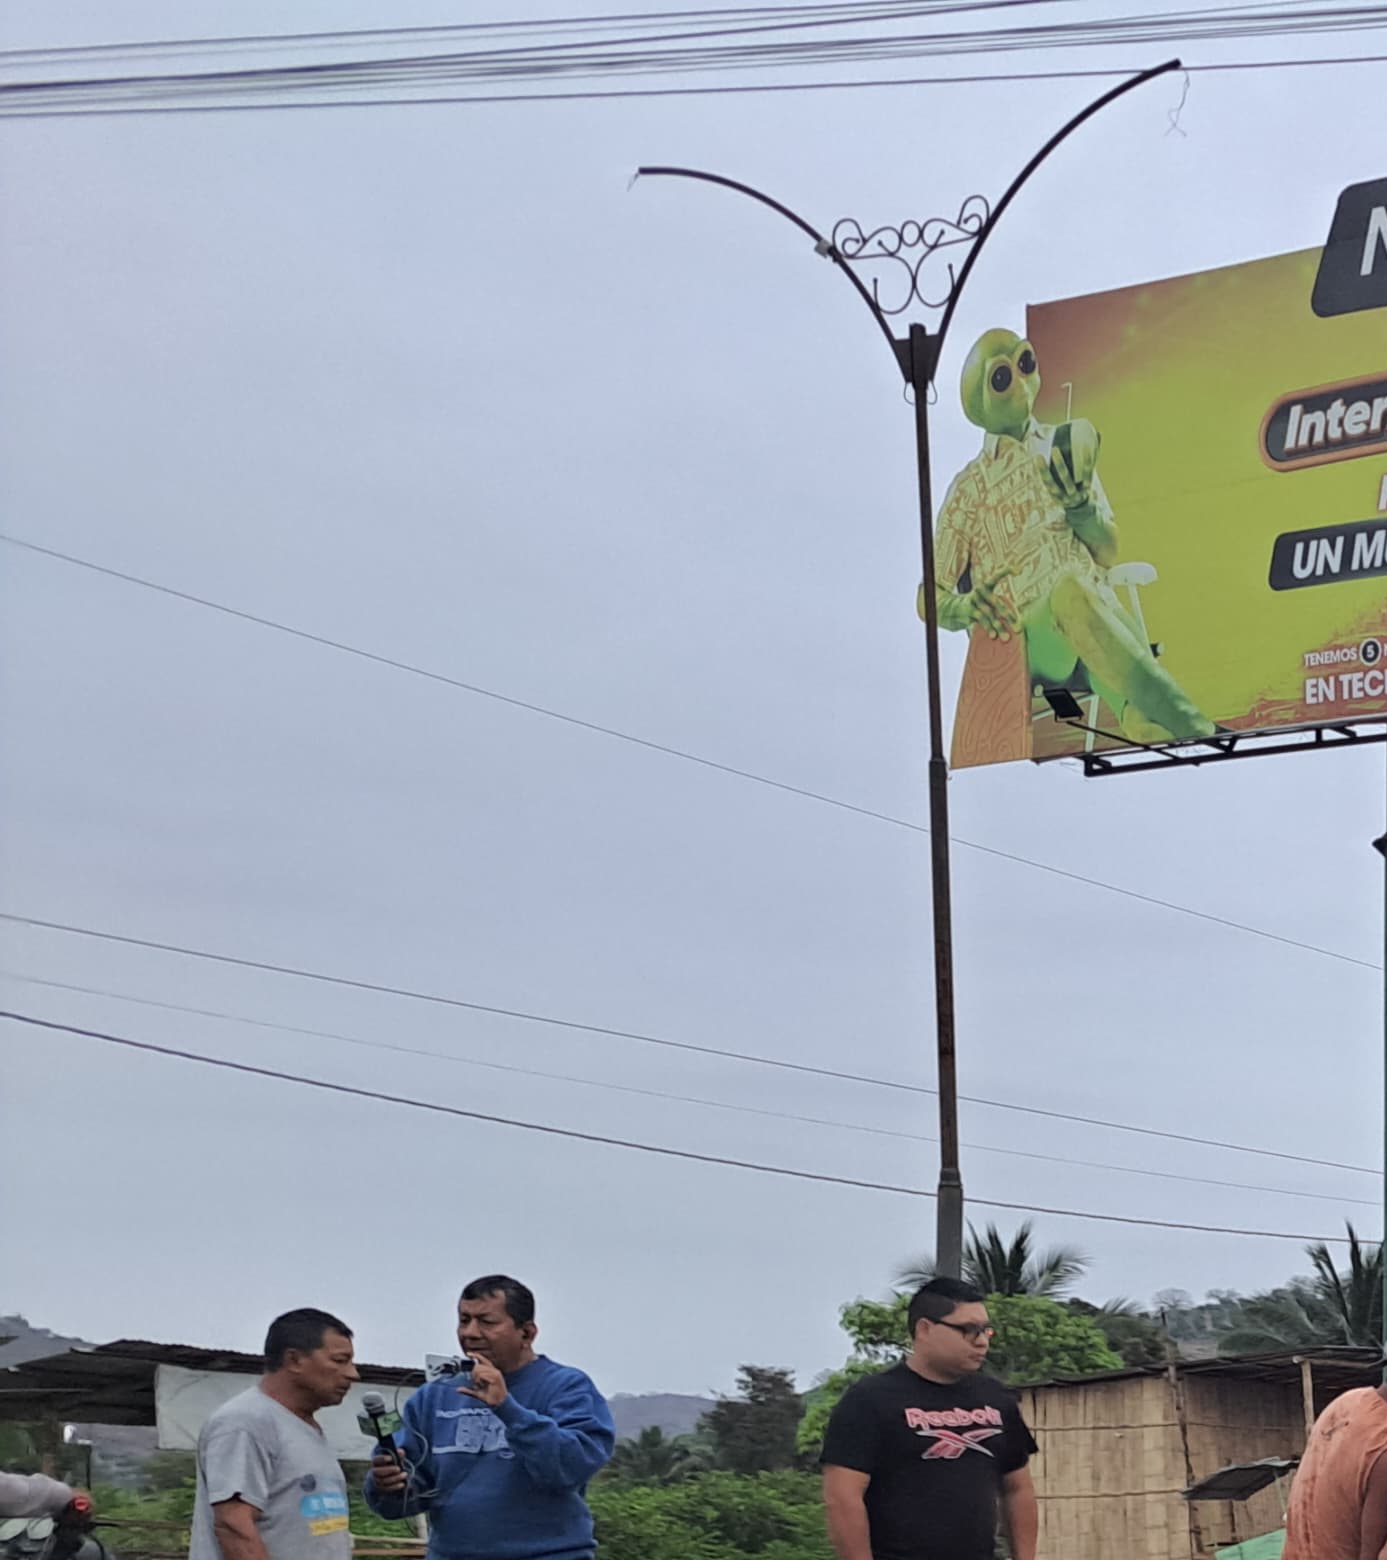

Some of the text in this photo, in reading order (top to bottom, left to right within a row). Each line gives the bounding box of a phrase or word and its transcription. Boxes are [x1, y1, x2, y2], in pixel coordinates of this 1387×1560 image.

[1292, 536, 1344, 580] UN
[1303, 646, 1358, 668] TENEMOS
[1305, 677, 1335, 705] EN
[904, 1405, 1004, 1432] Reebok
